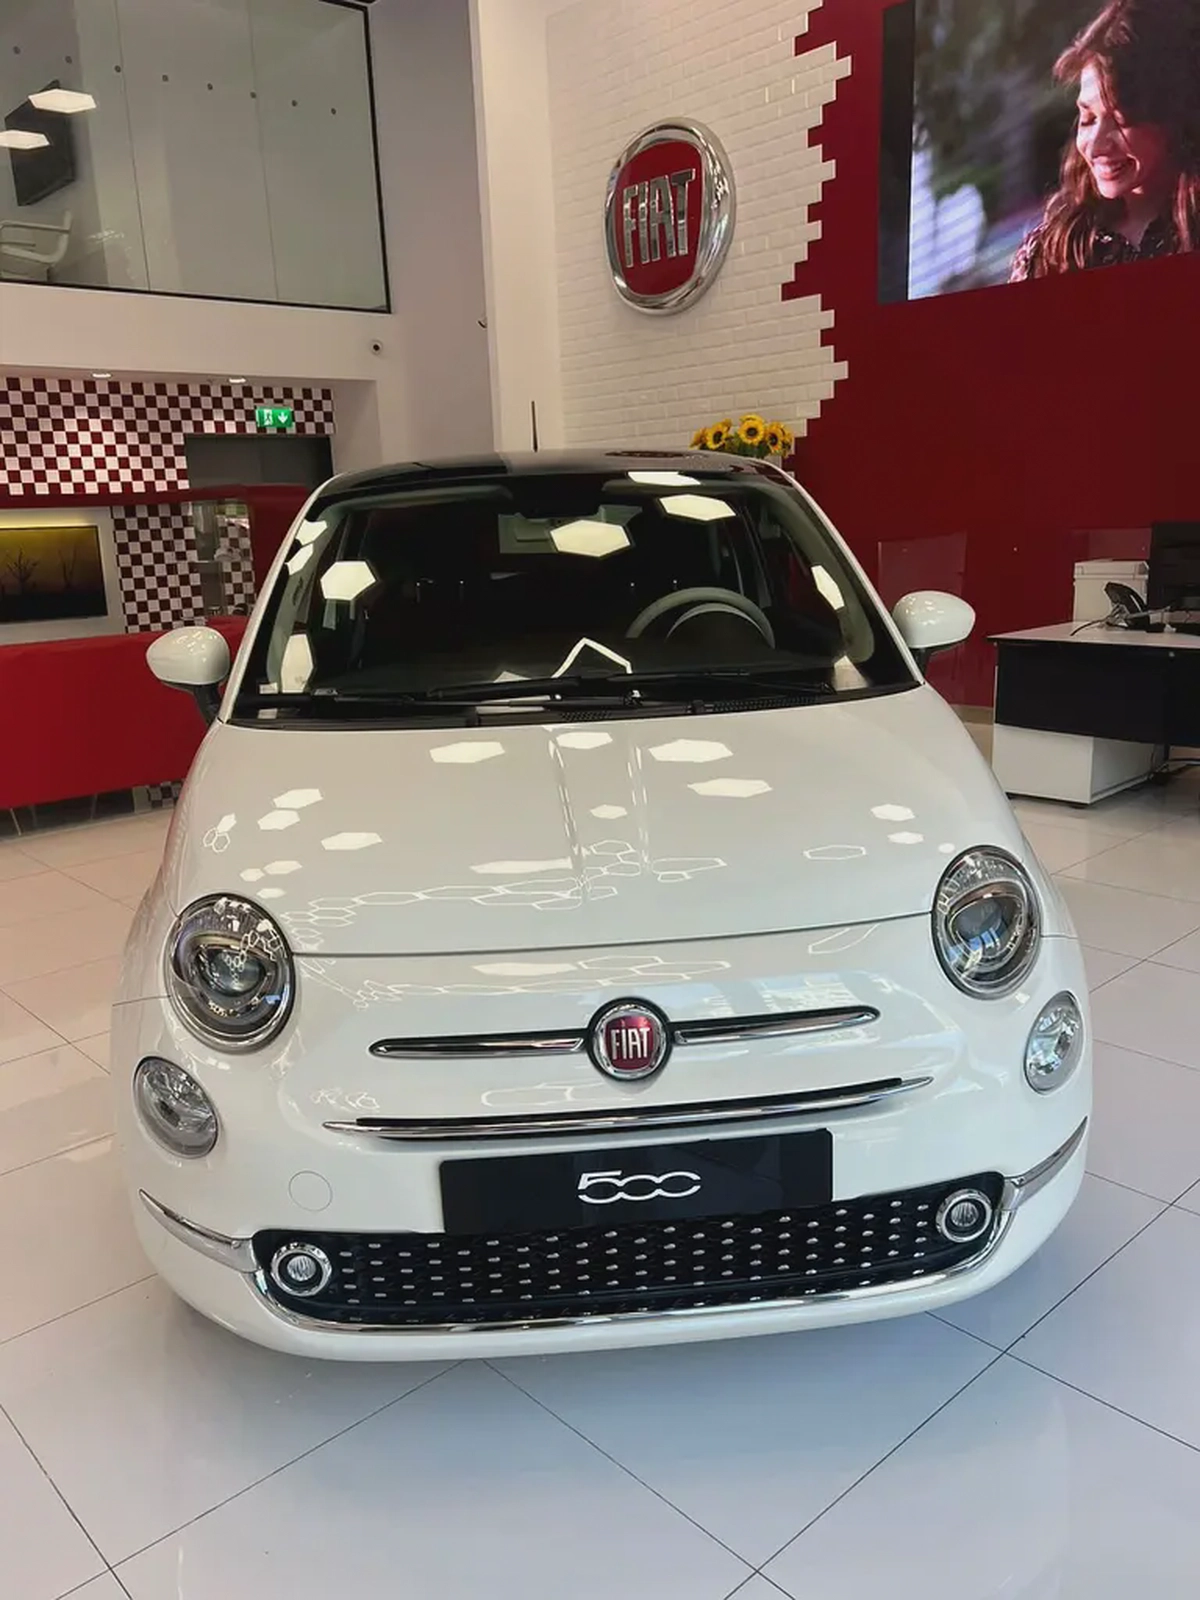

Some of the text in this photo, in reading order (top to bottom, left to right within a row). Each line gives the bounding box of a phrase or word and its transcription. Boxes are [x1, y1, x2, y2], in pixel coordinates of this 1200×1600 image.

[622, 168, 696, 269] FIAT
[610, 1027, 651, 1060] FIAT
[577, 1170, 701, 1204] 500
